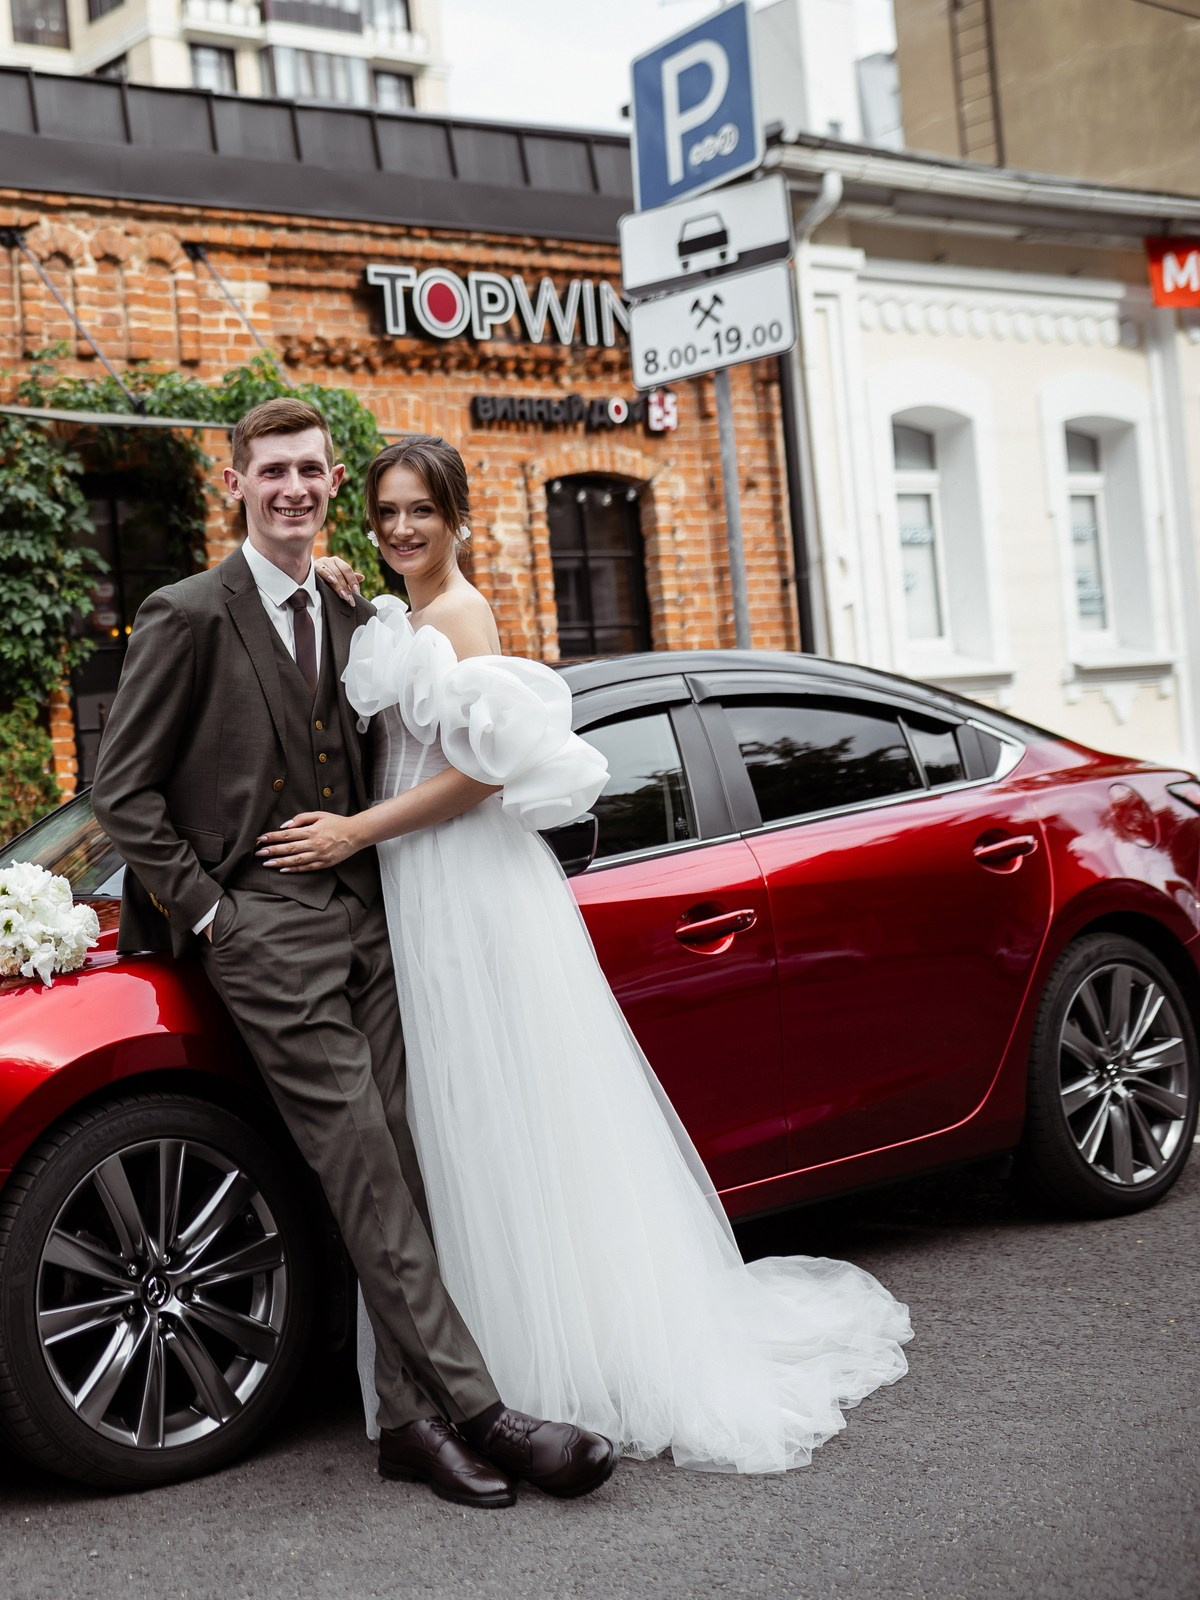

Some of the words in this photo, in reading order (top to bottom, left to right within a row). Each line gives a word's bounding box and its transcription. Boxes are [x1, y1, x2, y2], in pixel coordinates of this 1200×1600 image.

[660, 38, 730, 187] P
[643, 321, 783, 376] 8.00-19.00
[475, 393, 584, 423] ВИННЫЙ
